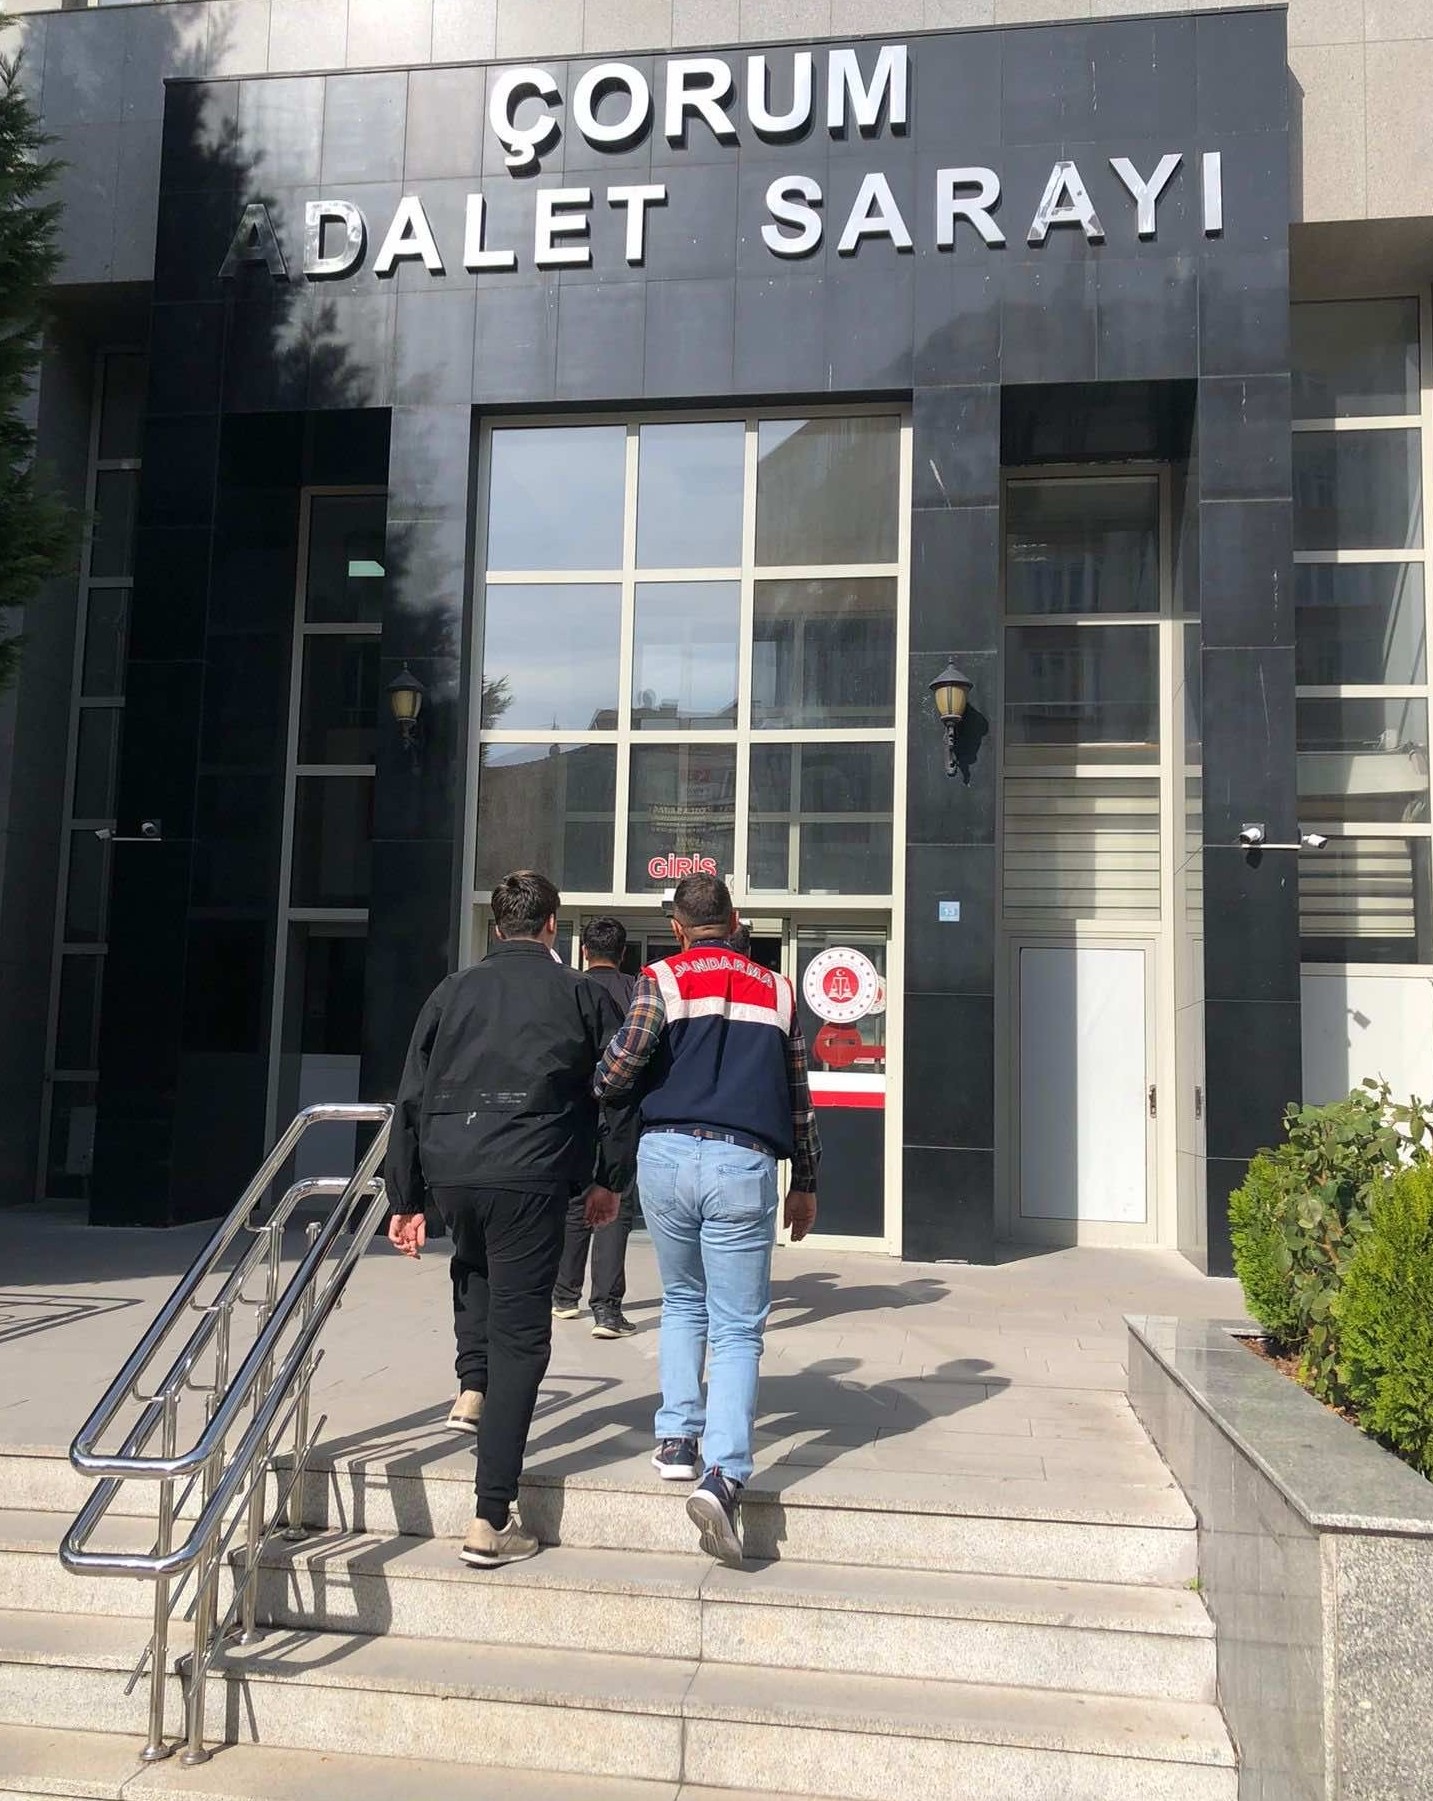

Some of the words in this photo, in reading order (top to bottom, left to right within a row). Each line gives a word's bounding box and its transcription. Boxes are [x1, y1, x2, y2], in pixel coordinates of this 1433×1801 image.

[489, 45, 909, 170] ÇORUM
[217, 184, 667, 280] ADALET
[761, 151, 1223, 257] SARAYI
